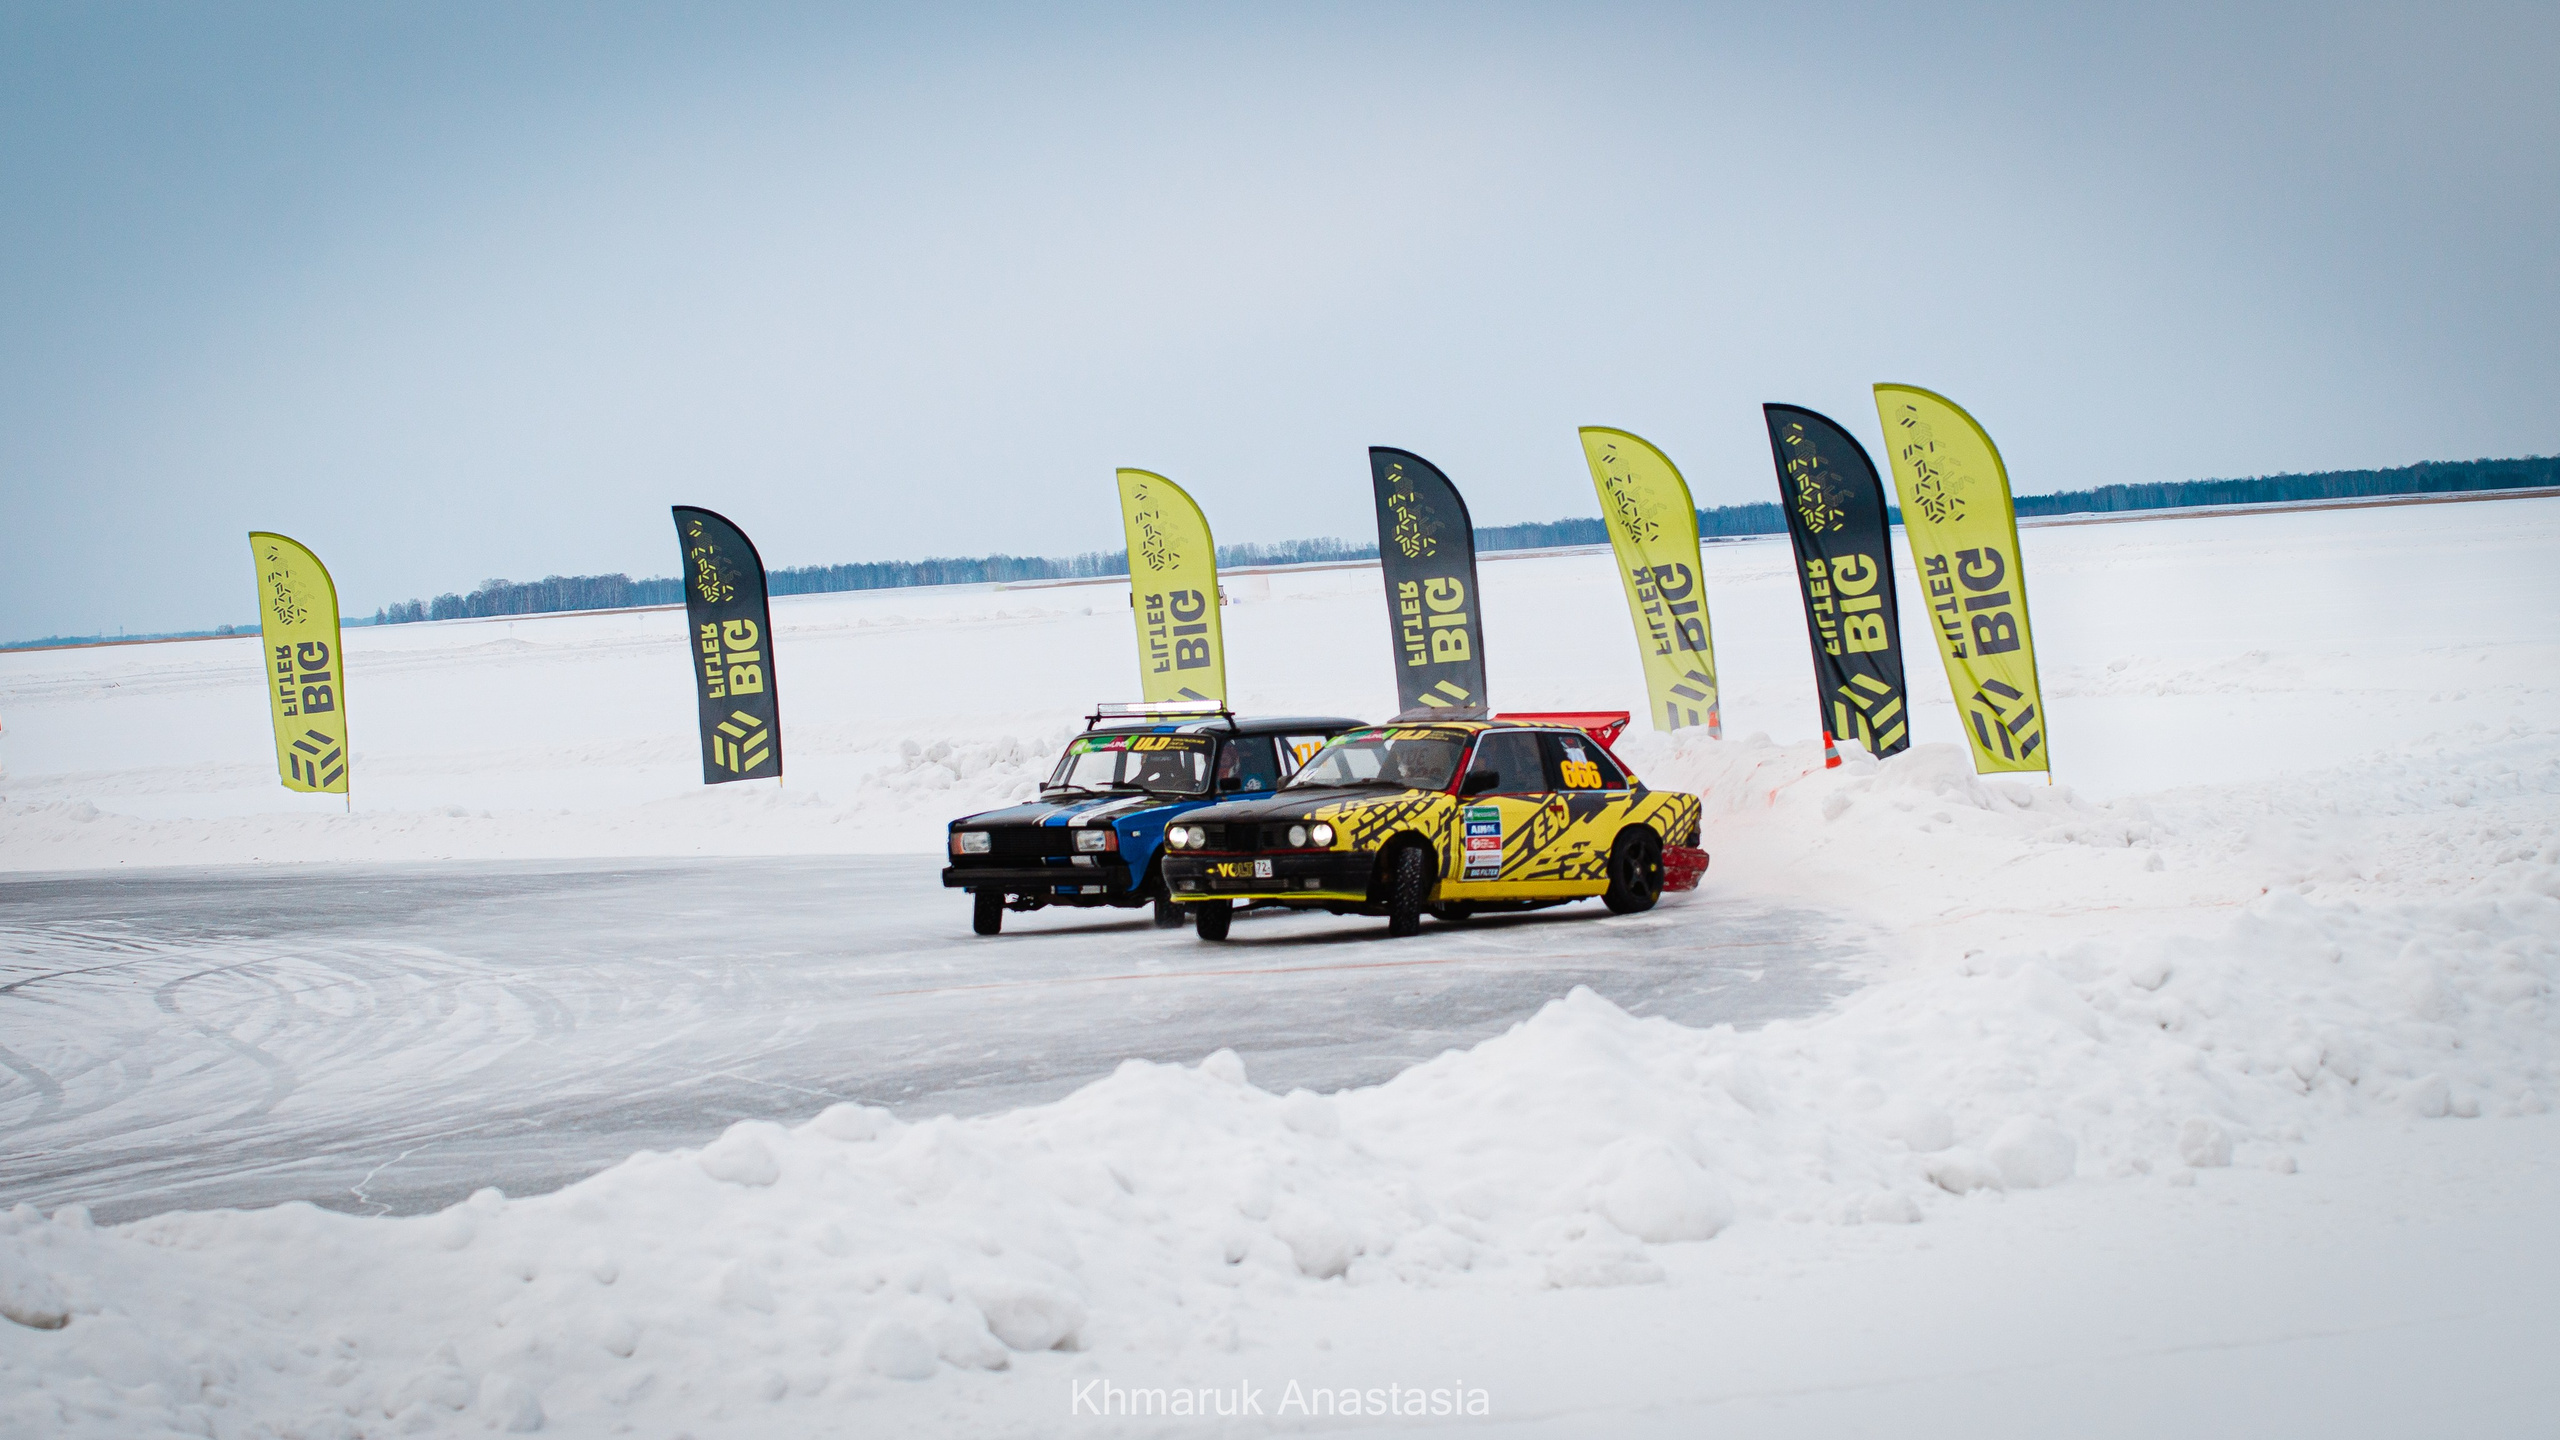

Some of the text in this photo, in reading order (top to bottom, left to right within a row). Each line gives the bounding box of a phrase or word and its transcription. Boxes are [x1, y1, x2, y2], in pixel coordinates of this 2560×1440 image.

[1133, 736, 1172, 751] ULD
[1560, 760, 1602, 789] 666
[1217, 862, 1253, 877] VOLT
[1256, 862, 1267, 872] 72
